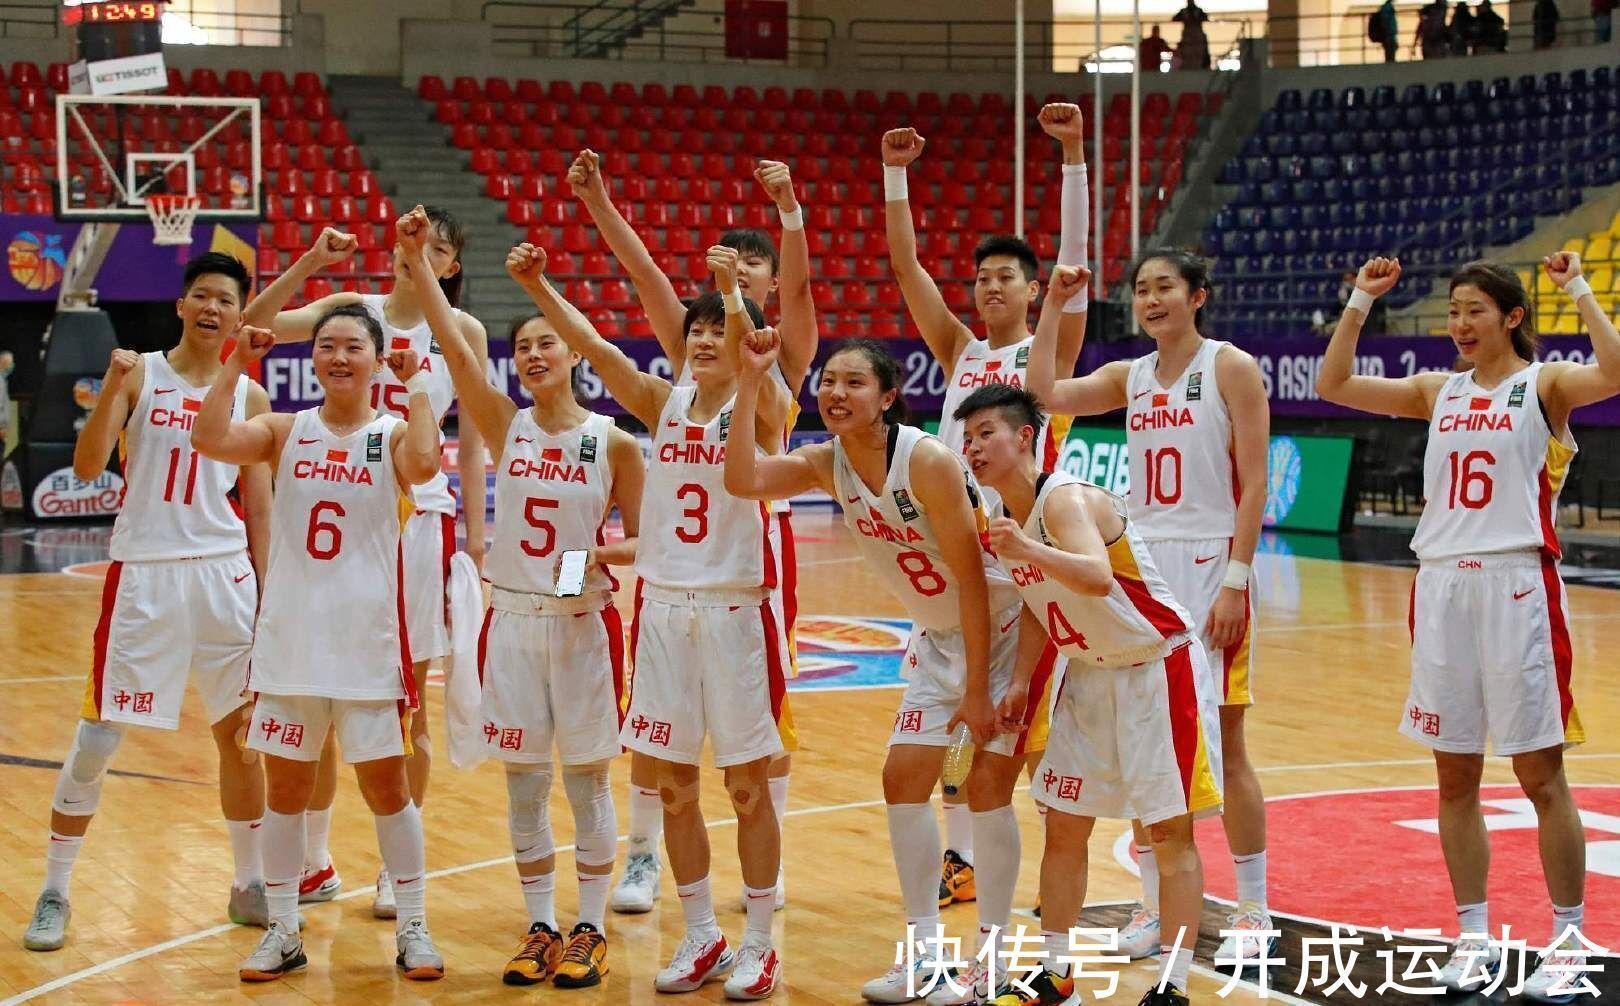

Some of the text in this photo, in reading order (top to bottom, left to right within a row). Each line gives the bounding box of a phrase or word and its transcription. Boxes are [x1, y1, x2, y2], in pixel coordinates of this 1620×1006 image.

[115, 66, 158, 80] TISSOT
[266, 358, 326, 401] FIB
[959, 373, 1022, 388] CHINA
[1277, 355, 1323, 400] ASI
[151, 408, 193, 431] CHI
[1130, 407, 1194, 432] CHINA
[1438, 413, 1513, 433] CHINA
[659, 443, 725, 465] CHINA
[1061, 438, 1130, 497] @FIB
[163, 447, 199, 505] 11
[294, 460, 374, 486] CHINA
[508, 458, 587, 485] CHINA
[1144, 447, 1182, 506] 10
[1448, 450, 1496, 510] 16
[40, 490, 120, 514] Gante
[675, 483, 709, 544] 3
[306, 500, 346, 561] 6
[520, 497, 559, 558] 5
[856, 518, 925, 543] CHINA
[896, 551, 947, 597] 8
[1011, 563, 1045, 588] CHI
[1458, 559, 1482, 570] CHN
[1047, 601, 1090, 651] 4
[113, 690, 154, 714] 中国
[261, 718, 304, 749] 中国
[483, 722, 523, 751] 中国
[631, 714, 671, 747] 中国
[1409, 705, 1440, 737] 中国
[1043, 768, 1083, 801] 中国
